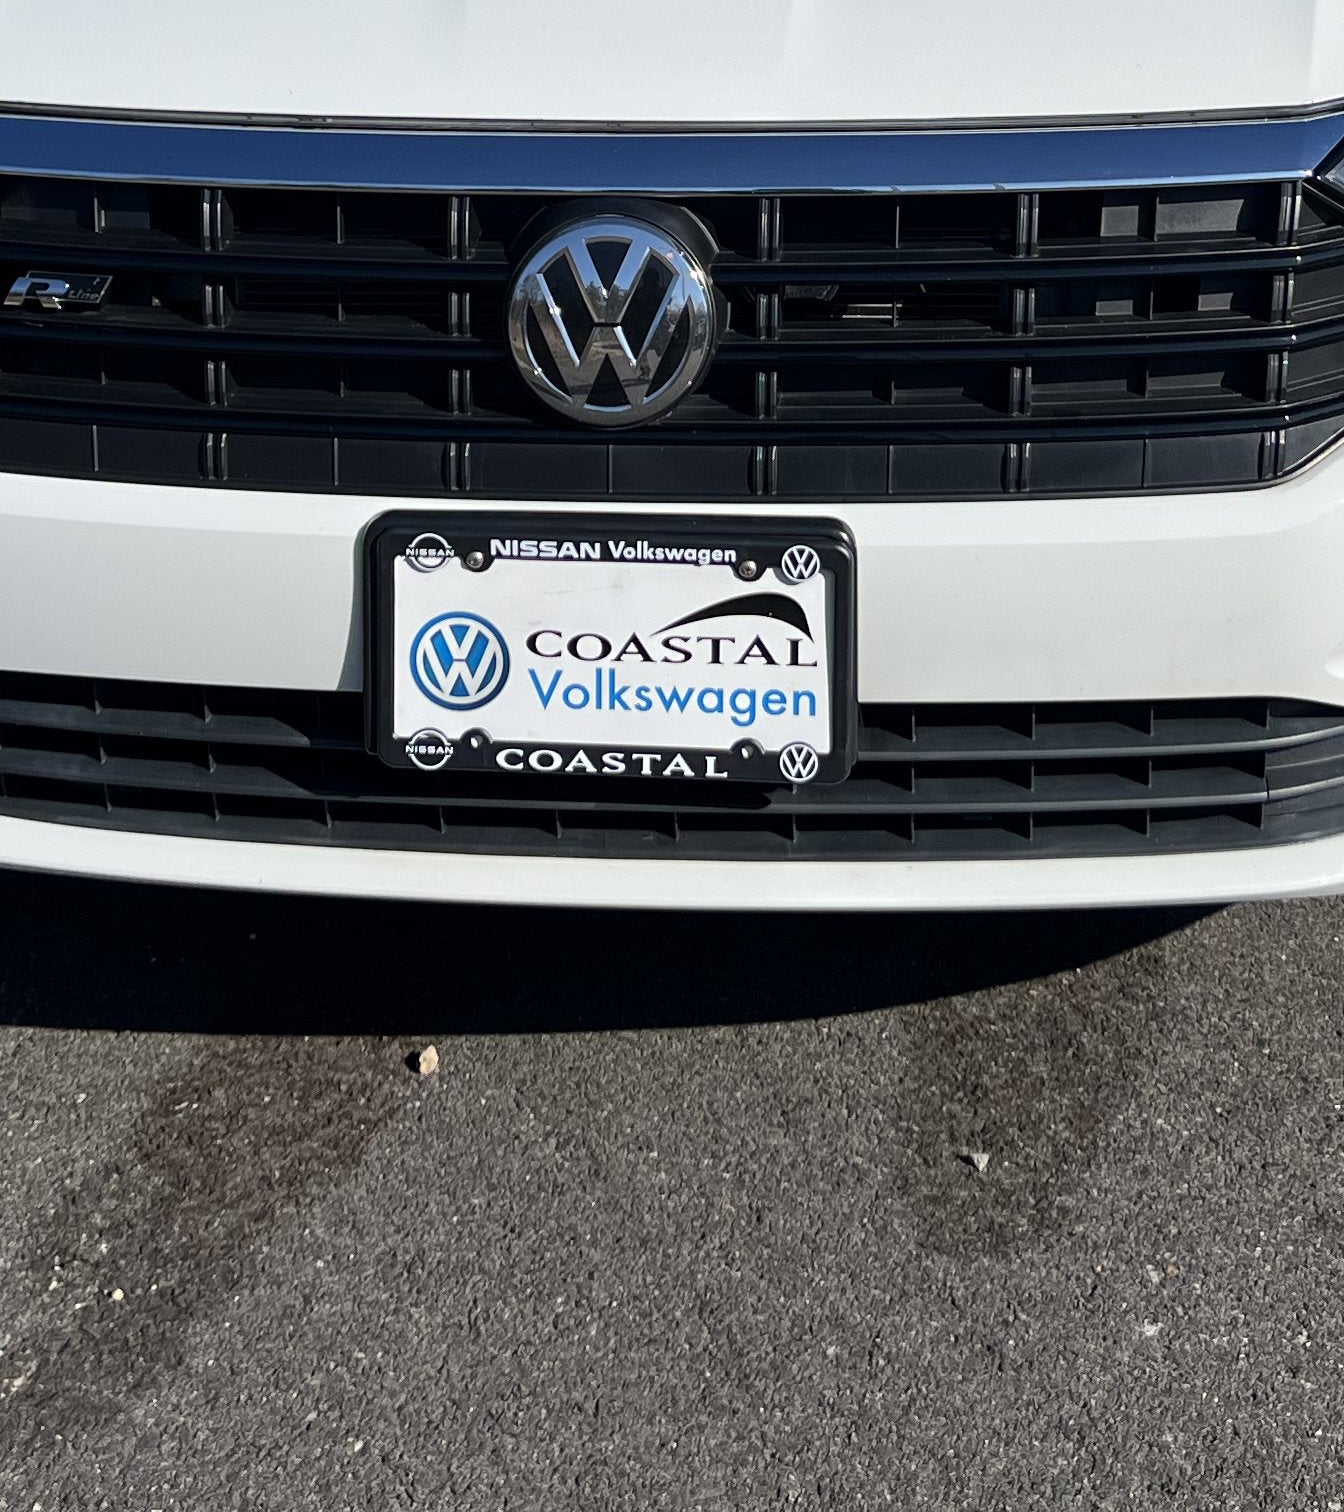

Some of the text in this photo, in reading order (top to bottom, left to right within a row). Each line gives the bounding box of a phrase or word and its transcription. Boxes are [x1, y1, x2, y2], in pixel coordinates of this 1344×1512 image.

[406, 548, 455, 558] NISSAN
[490, 538, 737, 566] NISSAN Volkswagen
[525, 629, 818, 668] COASTAL
[527, 668, 817, 727] Volkswagen
[405, 744, 454, 755] NISSAN
[495, 748, 728, 779] COASTAL
